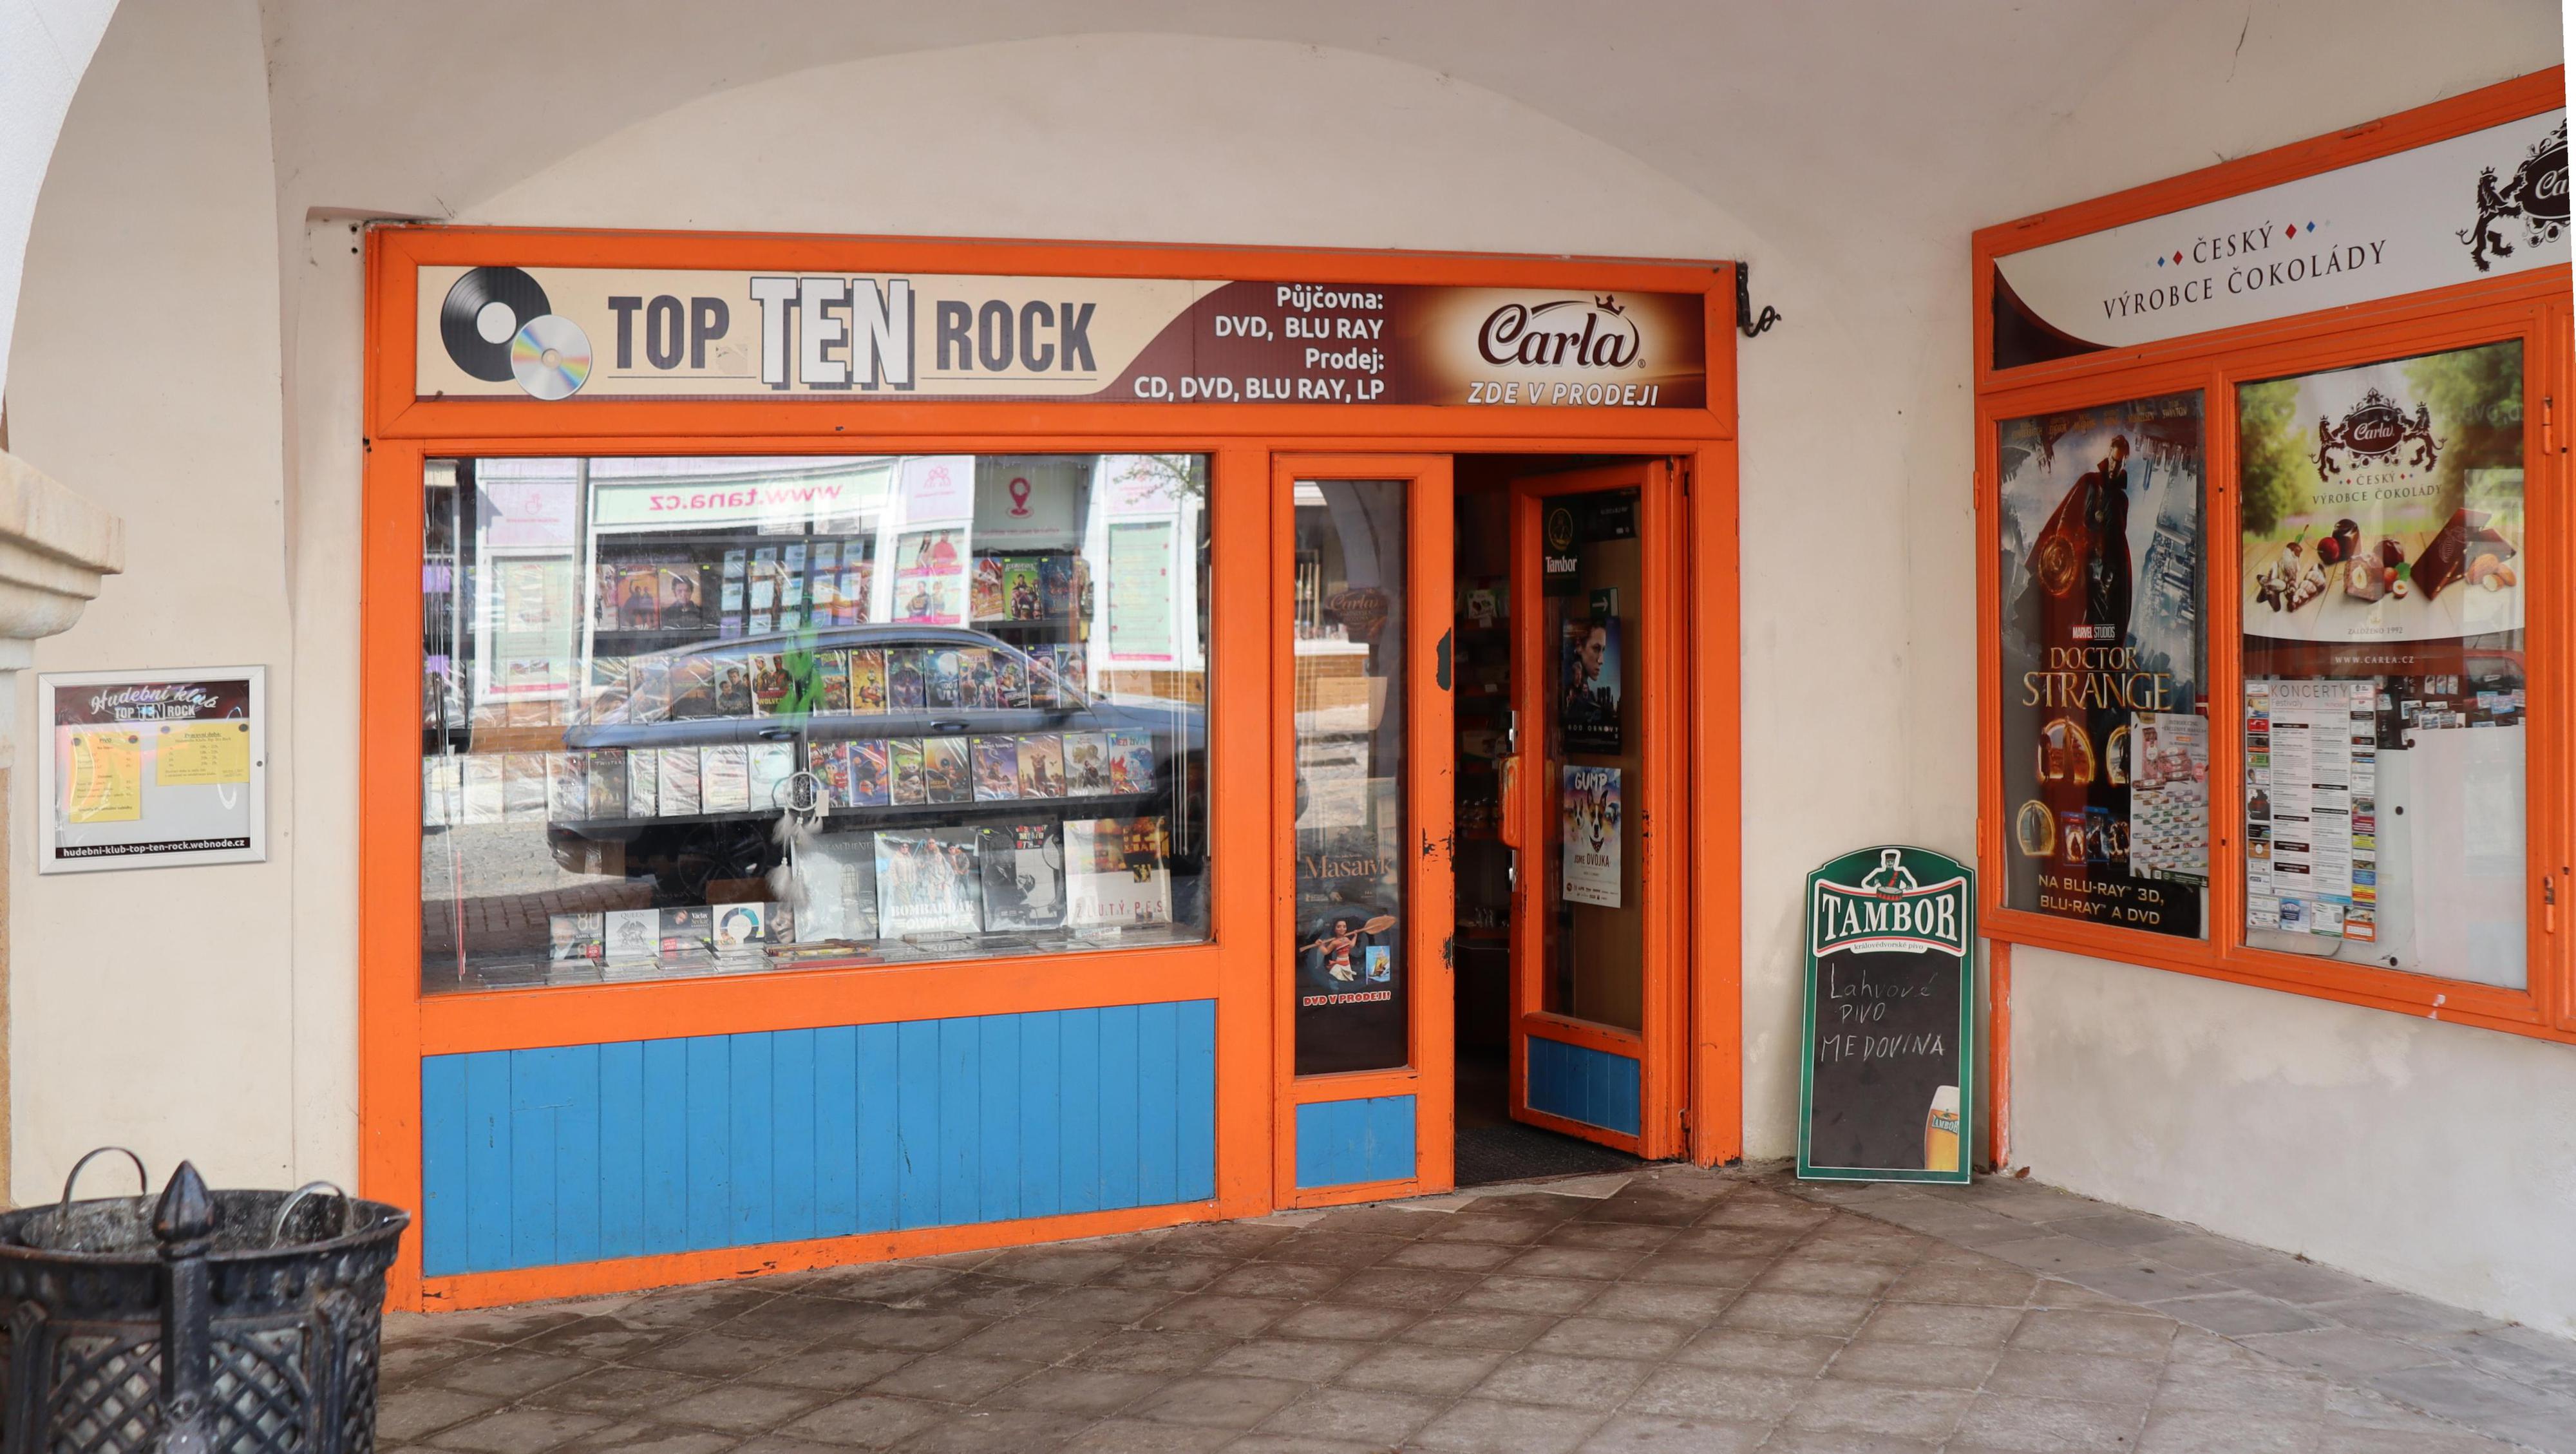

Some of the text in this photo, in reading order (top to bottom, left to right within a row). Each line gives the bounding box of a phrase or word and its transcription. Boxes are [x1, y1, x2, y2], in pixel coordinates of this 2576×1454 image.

[2193, 221, 2275, 265] ČESKÝ
[2103, 239, 2387, 321] VÝROBCE ČOKOLÁDY
[1276, 285, 1384, 312] Půjčovna:
[608, 276, 1097, 390] TOP TEN ROCK
[1215, 316, 1384, 341] DVD, BLU RAY
[1478, 299, 1640, 370] Carla
[1305, 347, 1385, 372] Prodej:
[1134, 375, 1385, 404] CD, DVD, BLU RAY, LP
[1467, 381, 1660, 407] ZDE V PRODEJI
[2354, 420, 2392, 441] Carla
[2356, 471, 2396, 487] ČESKÝ
[2313, 484, 2443, 506] VÝROBCE ČOKOLÁDY
[1546, 554, 1577, 573] Tambor
[1331, 592, 1379, 611] Carla
[2072, 624, 2115, 640] MARVEL STUDIOS
[2050, 647, 2139, 670] DOCTOR
[2335, 656, 2415, 665] WWW.CARLA.CZ
[2022, 672, 2174, 710] STRANGE
[2271, 684, 2348, 698] KONCERTY
[115, 708, 135, 719] TOP
[167, 705, 195, 717] ROCK
[1575, 773, 1608, 791] GUMP
[63, 838, 245, 857] hudebni-klub-top-ten-rock.webnode.cz
[1304, 854, 1392, 882] Masaryk
[1586, 853, 1609, 867] DVOJKA
[2039, 874, 2058, 889] NA
[2137, 887, 2164, 906] 3D,
[620, 912, 644, 921] QUEEN
[1135, 900, 1163, 914] PES
[1822, 893, 1958, 942] TAMBOR
[2111, 906, 2122, 919] A
[2126, 908, 2160, 925] DVD
[1830, 963, 1938, 999] Lahvové
[1303, 991, 1392, 1006] DVD V PRODEJI!
[1839, 1002, 1886, 1024] PIVO
